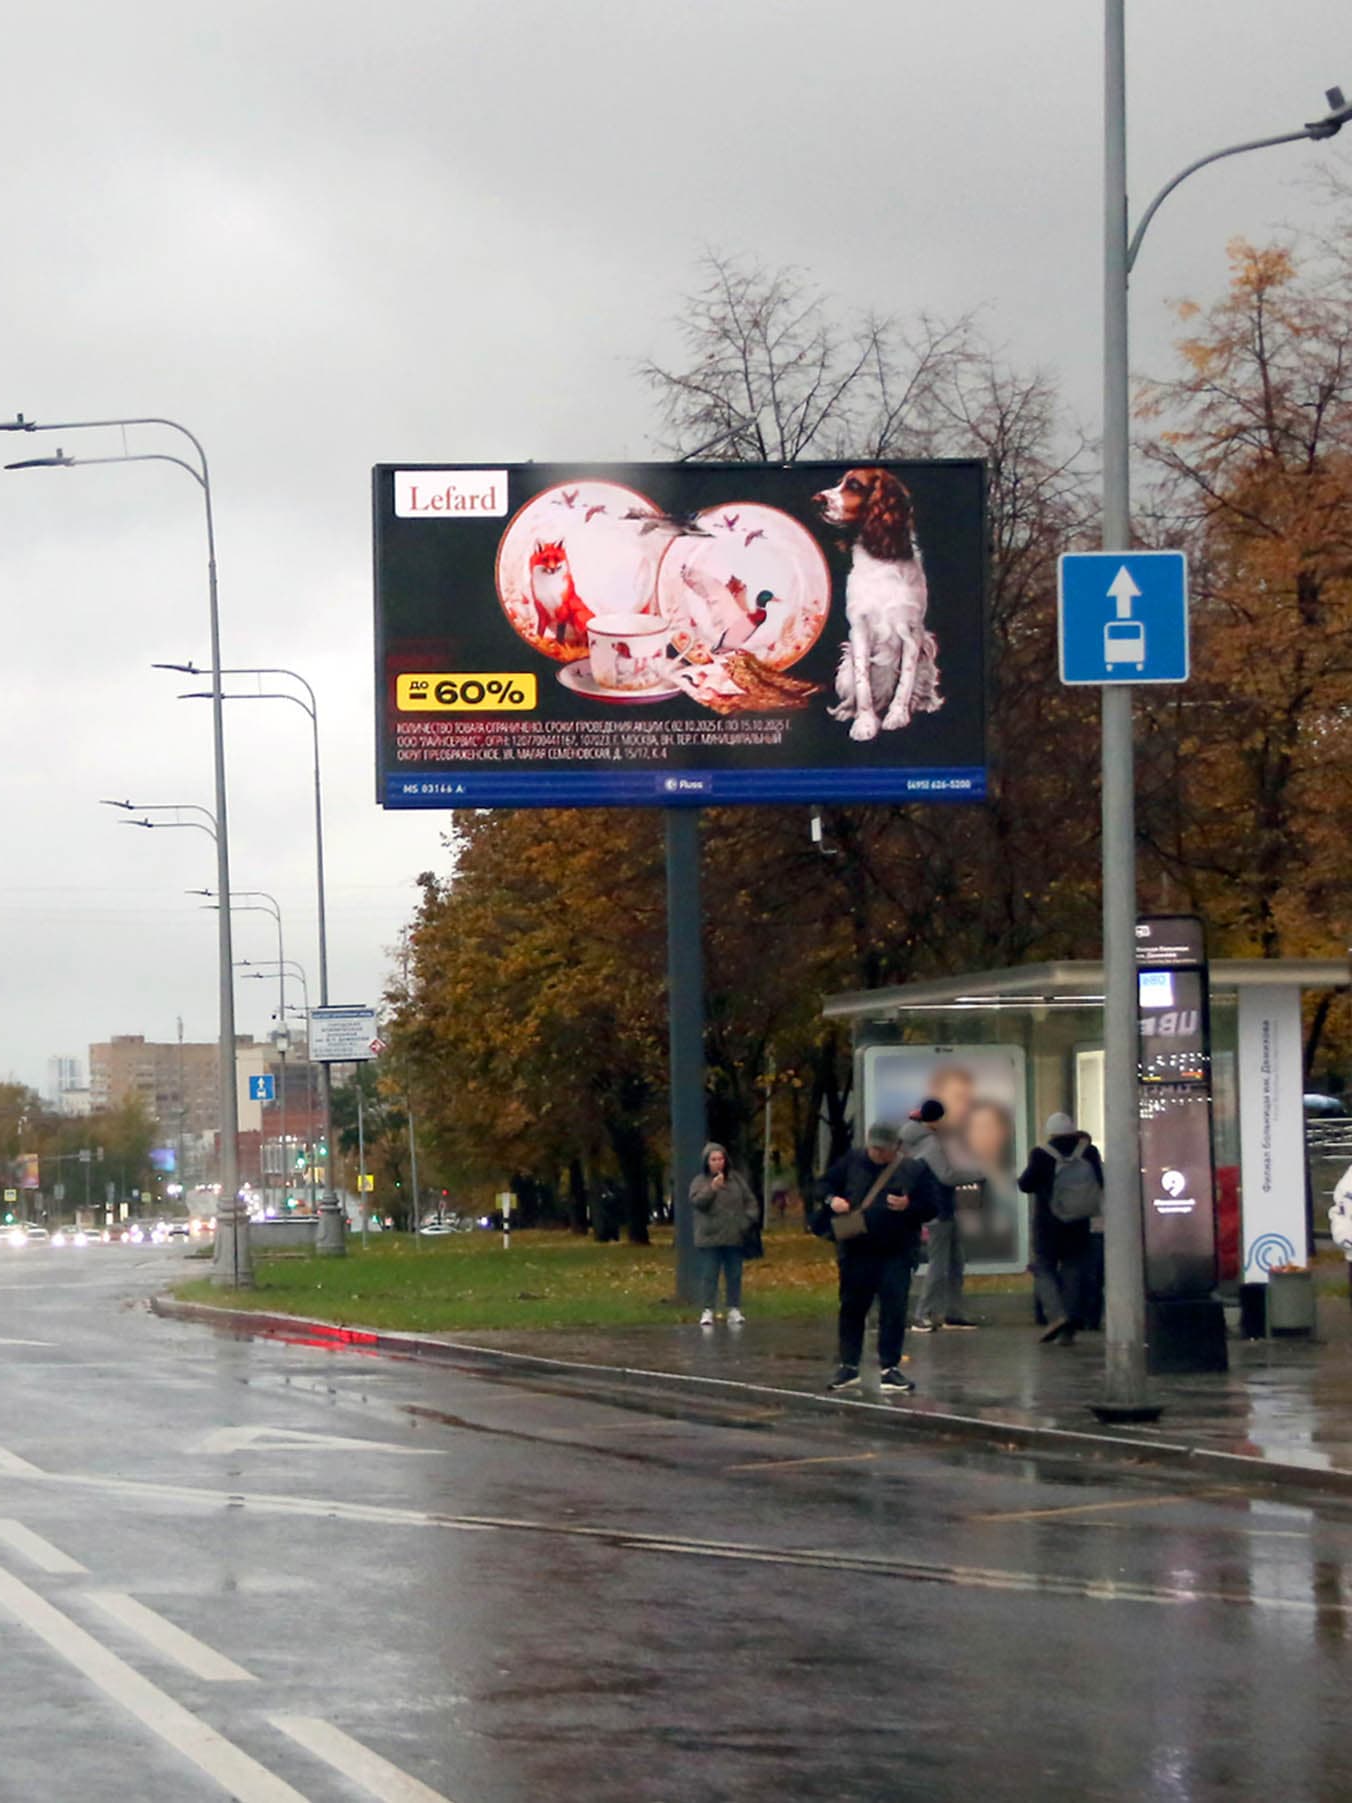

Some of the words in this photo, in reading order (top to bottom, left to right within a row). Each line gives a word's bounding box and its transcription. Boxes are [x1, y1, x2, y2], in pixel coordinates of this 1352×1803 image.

[409, 486, 497, 512] Lefard
[397, 722, 453, 734] КОЛИЧЕСТВО
[455, 722, 484, 734] ТОВАРА
[545, 721, 574, 733] СРОКИ
[575, 721, 632, 733] ПРОВЕДЕНИЯ
[633, 720, 663, 733] АКЦИИ
[397, 736, 416, 747] ООО
[701, 733, 782, 745] МУНИЦИПАЛЬНЫЙ
[397, 749, 421, 760] ОКРУГ
[517, 748, 546, 760] МАЛАЯ
[403, 784, 418, 793] MS
[456, 784, 464, 793] A
